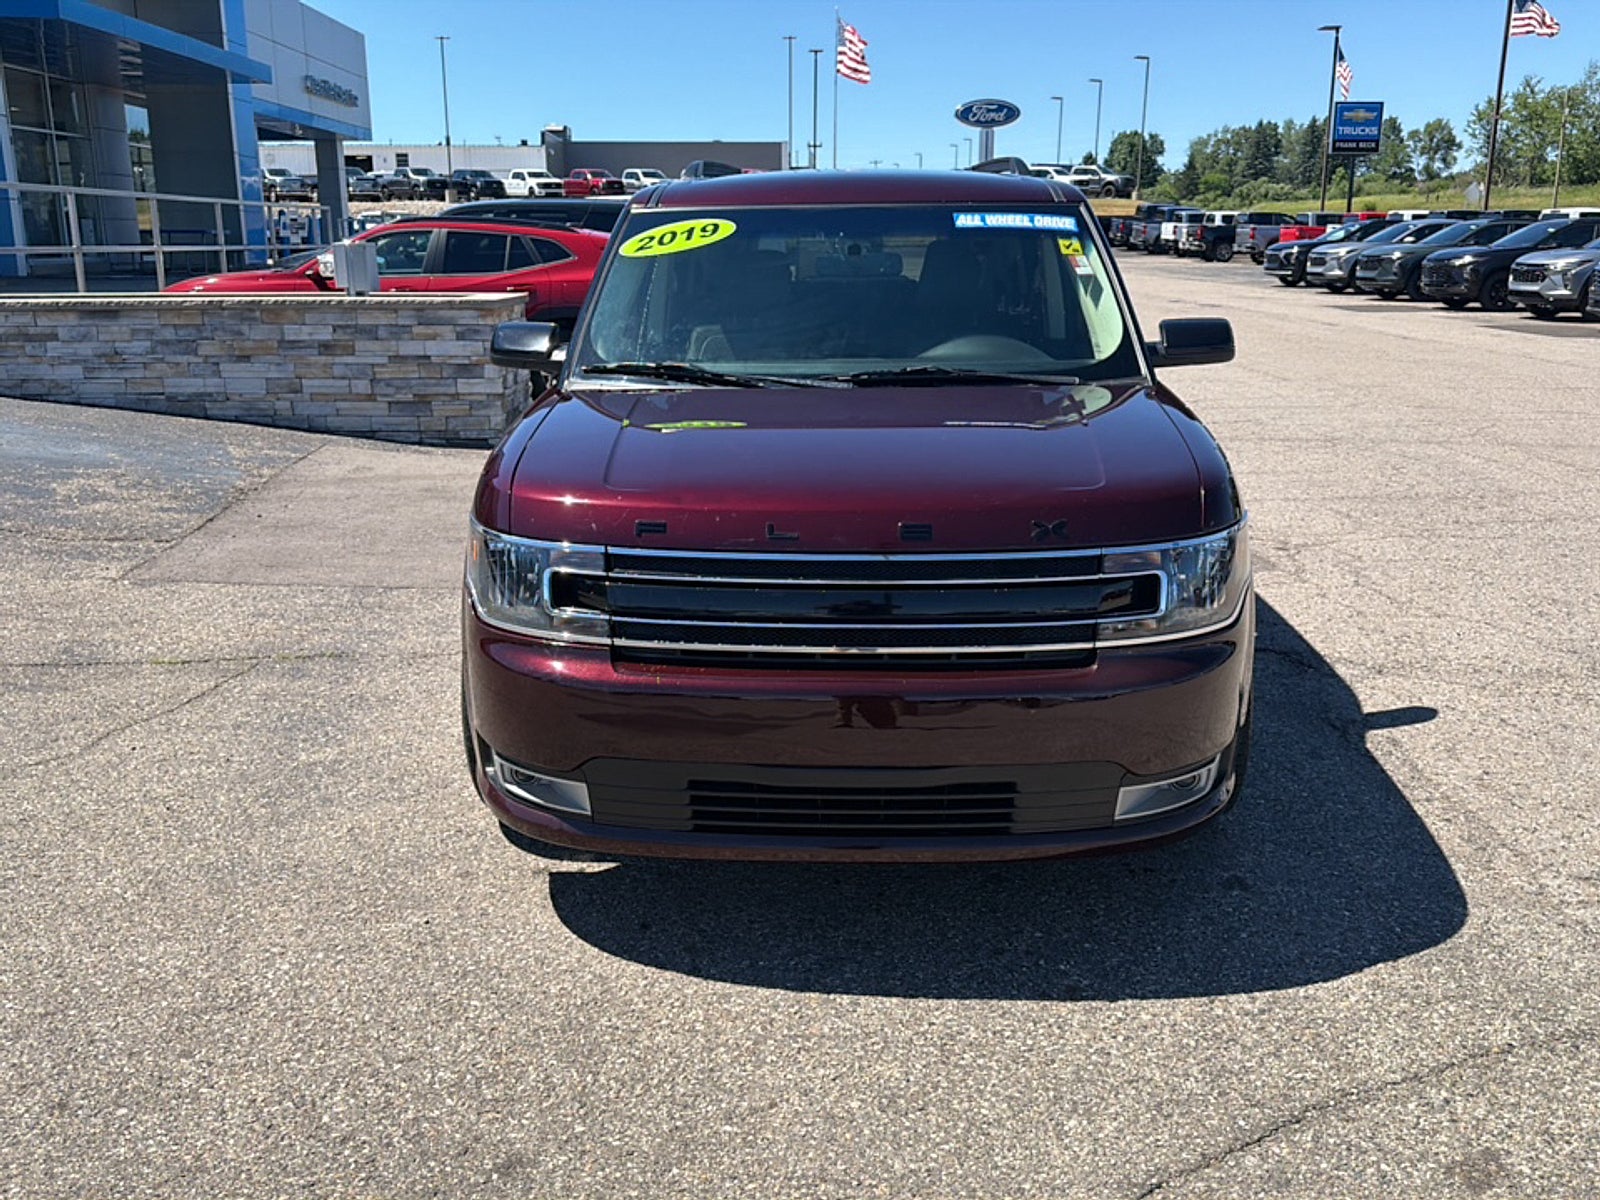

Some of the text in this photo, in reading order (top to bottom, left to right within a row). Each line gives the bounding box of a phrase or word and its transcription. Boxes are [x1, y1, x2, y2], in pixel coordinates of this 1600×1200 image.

[968, 104, 1007, 121] Ford
[1338, 126, 1378, 135] TRUCKS
[956, 213, 1075, 229] ALL WHEEL DRIVE
[633, 223, 720, 253] 2019
